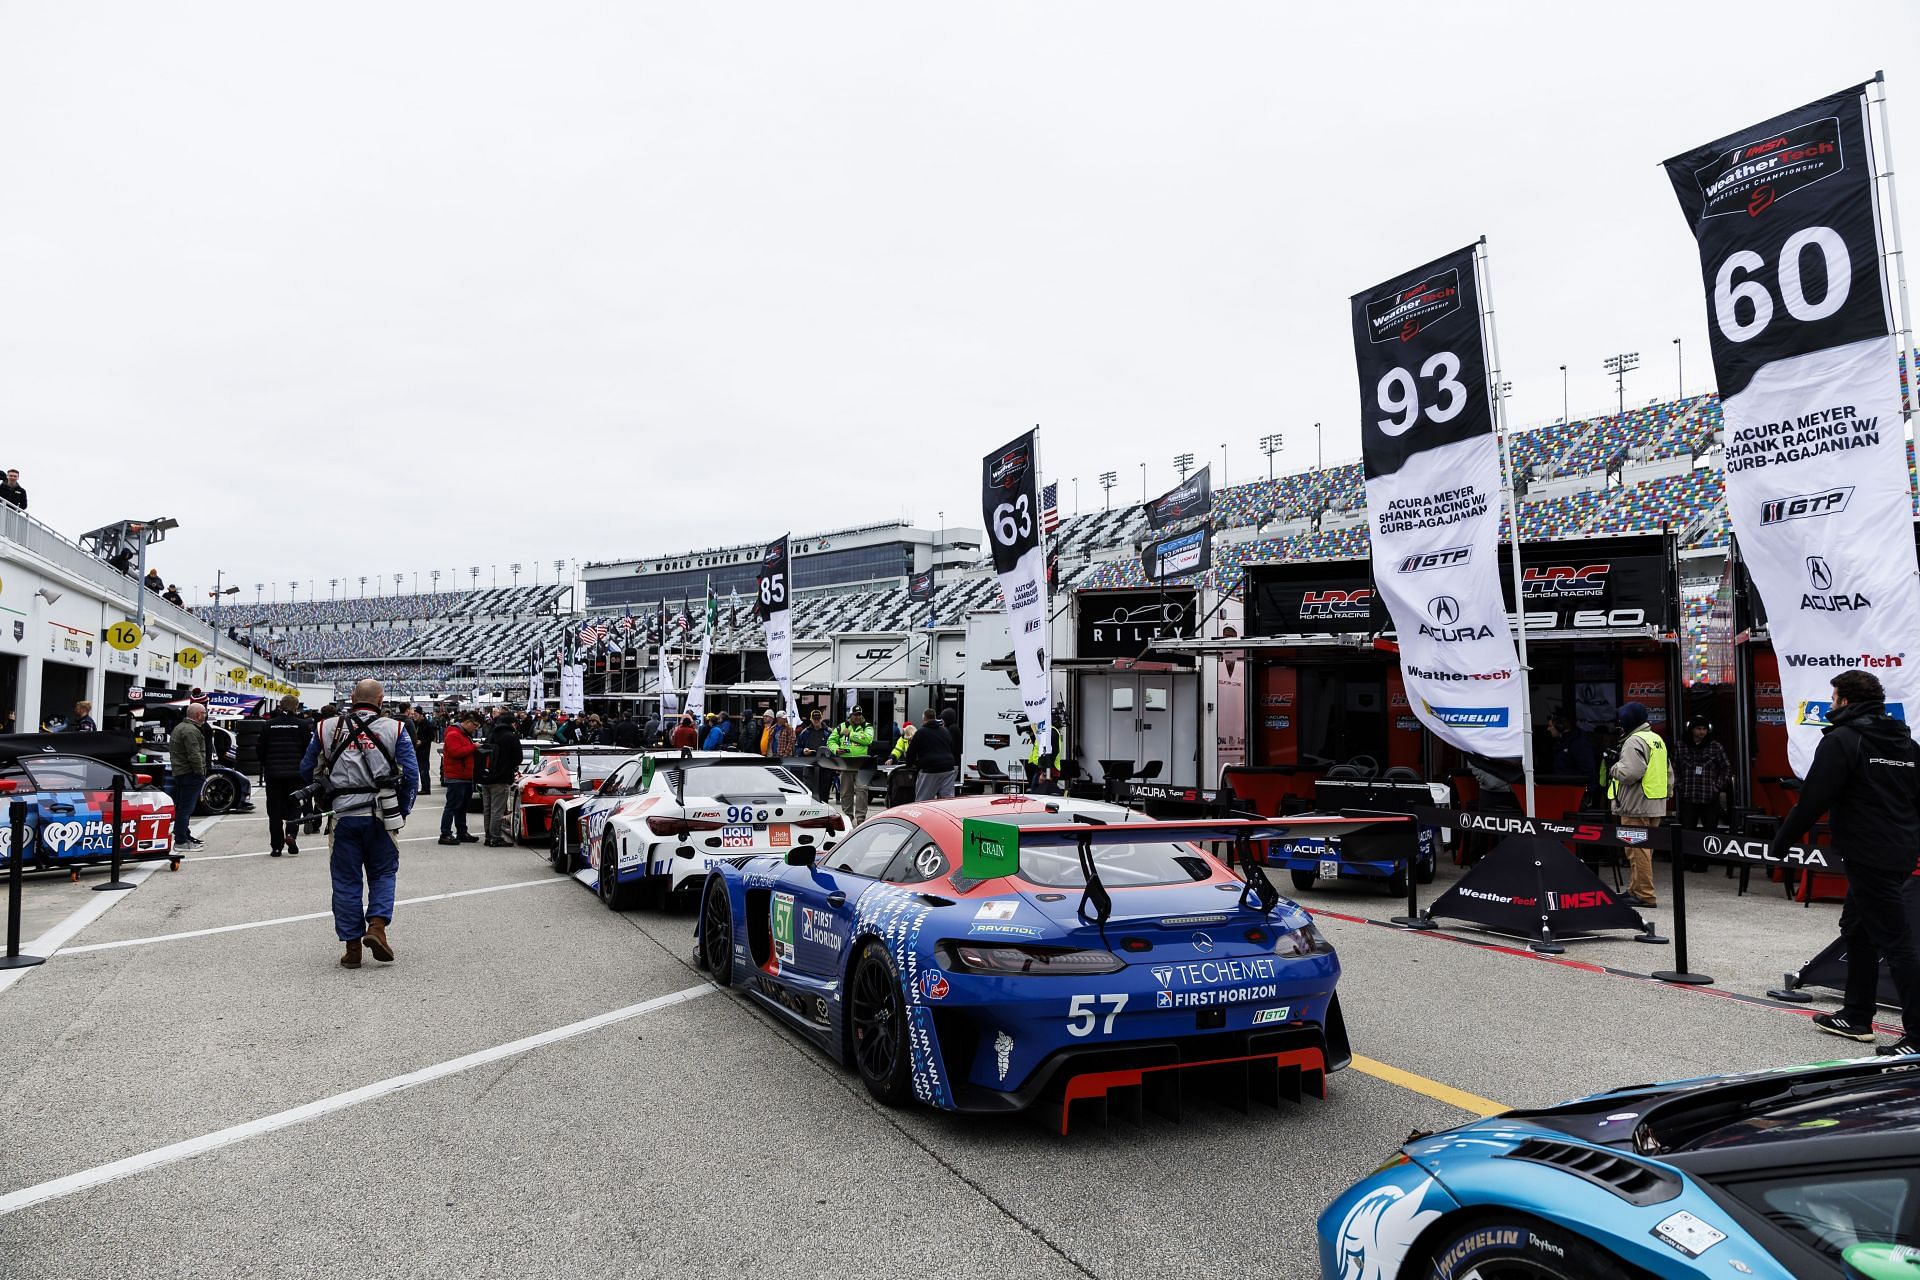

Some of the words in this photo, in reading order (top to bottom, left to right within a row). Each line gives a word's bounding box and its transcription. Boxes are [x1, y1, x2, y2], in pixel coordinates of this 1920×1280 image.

[1745, 137, 1788, 158] IMSA
[1706, 141, 1834, 198] WeatherTech
[1753, 161, 1825, 186] CHAMPIONSHIP
[1714, 226, 1852, 343] 60
[1373, 287, 1456, 328] WeatherTech
[1377, 351, 1468, 437] 93
[1733, 420, 1795, 443] ACURA
[1797, 405, 1857, 430] MEYER
[1725, 437, 1779, 461] SHANK
[1782, 422, 1848, 449] RACING
[1727, 432, 1880, 474] CURB-AGAJANIAN
[1388, 496, 1432, 511] ACURA
[1433, 485, 1475, 501] MEYER
[1788, 492, 1844, 516] GTP
[993, 493, 1032, 546] 63
[1379, 510, 1421, 524] SHANK
[1424, 499, 1470, 518] RACING
[655, 559, 691, 572] WORLD
[698, 553, 739, 567] CENTER
[746, 550, 760, 560] OF
[1421, 549, 1469, 568] GTP
[761, 573, 785, 605] 85
[1800, 592, 1872, 612] ACURA
[1573, 609, 1645, 627] 60
[115, 627, 136, 644] 16
[1093, 626, 1183, 641] RILEY
[1418, 623, 1495, 642] ACURA
[183, 652, 198, 664] 14
[1785, 653, 1905, 668] WeatherTech
[234, 670, 243, 679] 12
[254, 677, 263, 685] 10
[1407, 665, 1512, 681] WeatherTech
[1869, 757, 1916, 768] PORSCHE
[1135, 786, 1166, 798] ACURA
[727, 807, 753, 823] 96
[85, 820, 137, 836] iHert
[150, 820, 160, 840] 1
[723, 828, 752, 837] LIQUI
[1472, 815, 1536, 835] ACURA
[1541, 822, 1575, 833] Type
[1572, 825, 1603, 841] S
[82, 834, 135, 851] RADO
[723, 837, 752, 847] MOLY
[981, 841, 1004, 857] CRAIN
[1293, 845, 1337, 856] ACURA
[1723, 840, 1828, 867] ACURA
[1459, 887, 1537, 907] WeatherTech
[1561, 890, 1613, 909] IMSA
[776, 903, 791, 940] 57
[813, 910, 833, 929] FIRST
[813, 927, 842, 953] HORIZON
[976, 925, 1036, 935] RAVENOL
[1176, 959, 1275, 985] TECHEMET
[1175, 991, 1216, 1007] FIRST
[1219, 984, 1276, 1003] HORIZON
[1066, 993, 1129, 1038] 57
[1264, 1008, 1289, 1021] GTD
[1529, 1233, 1564, 1258] Daytona
[1659, 1234, 1675, 1247] SCAN
[1439, 1230, 1519, 1275] MICHELIN
